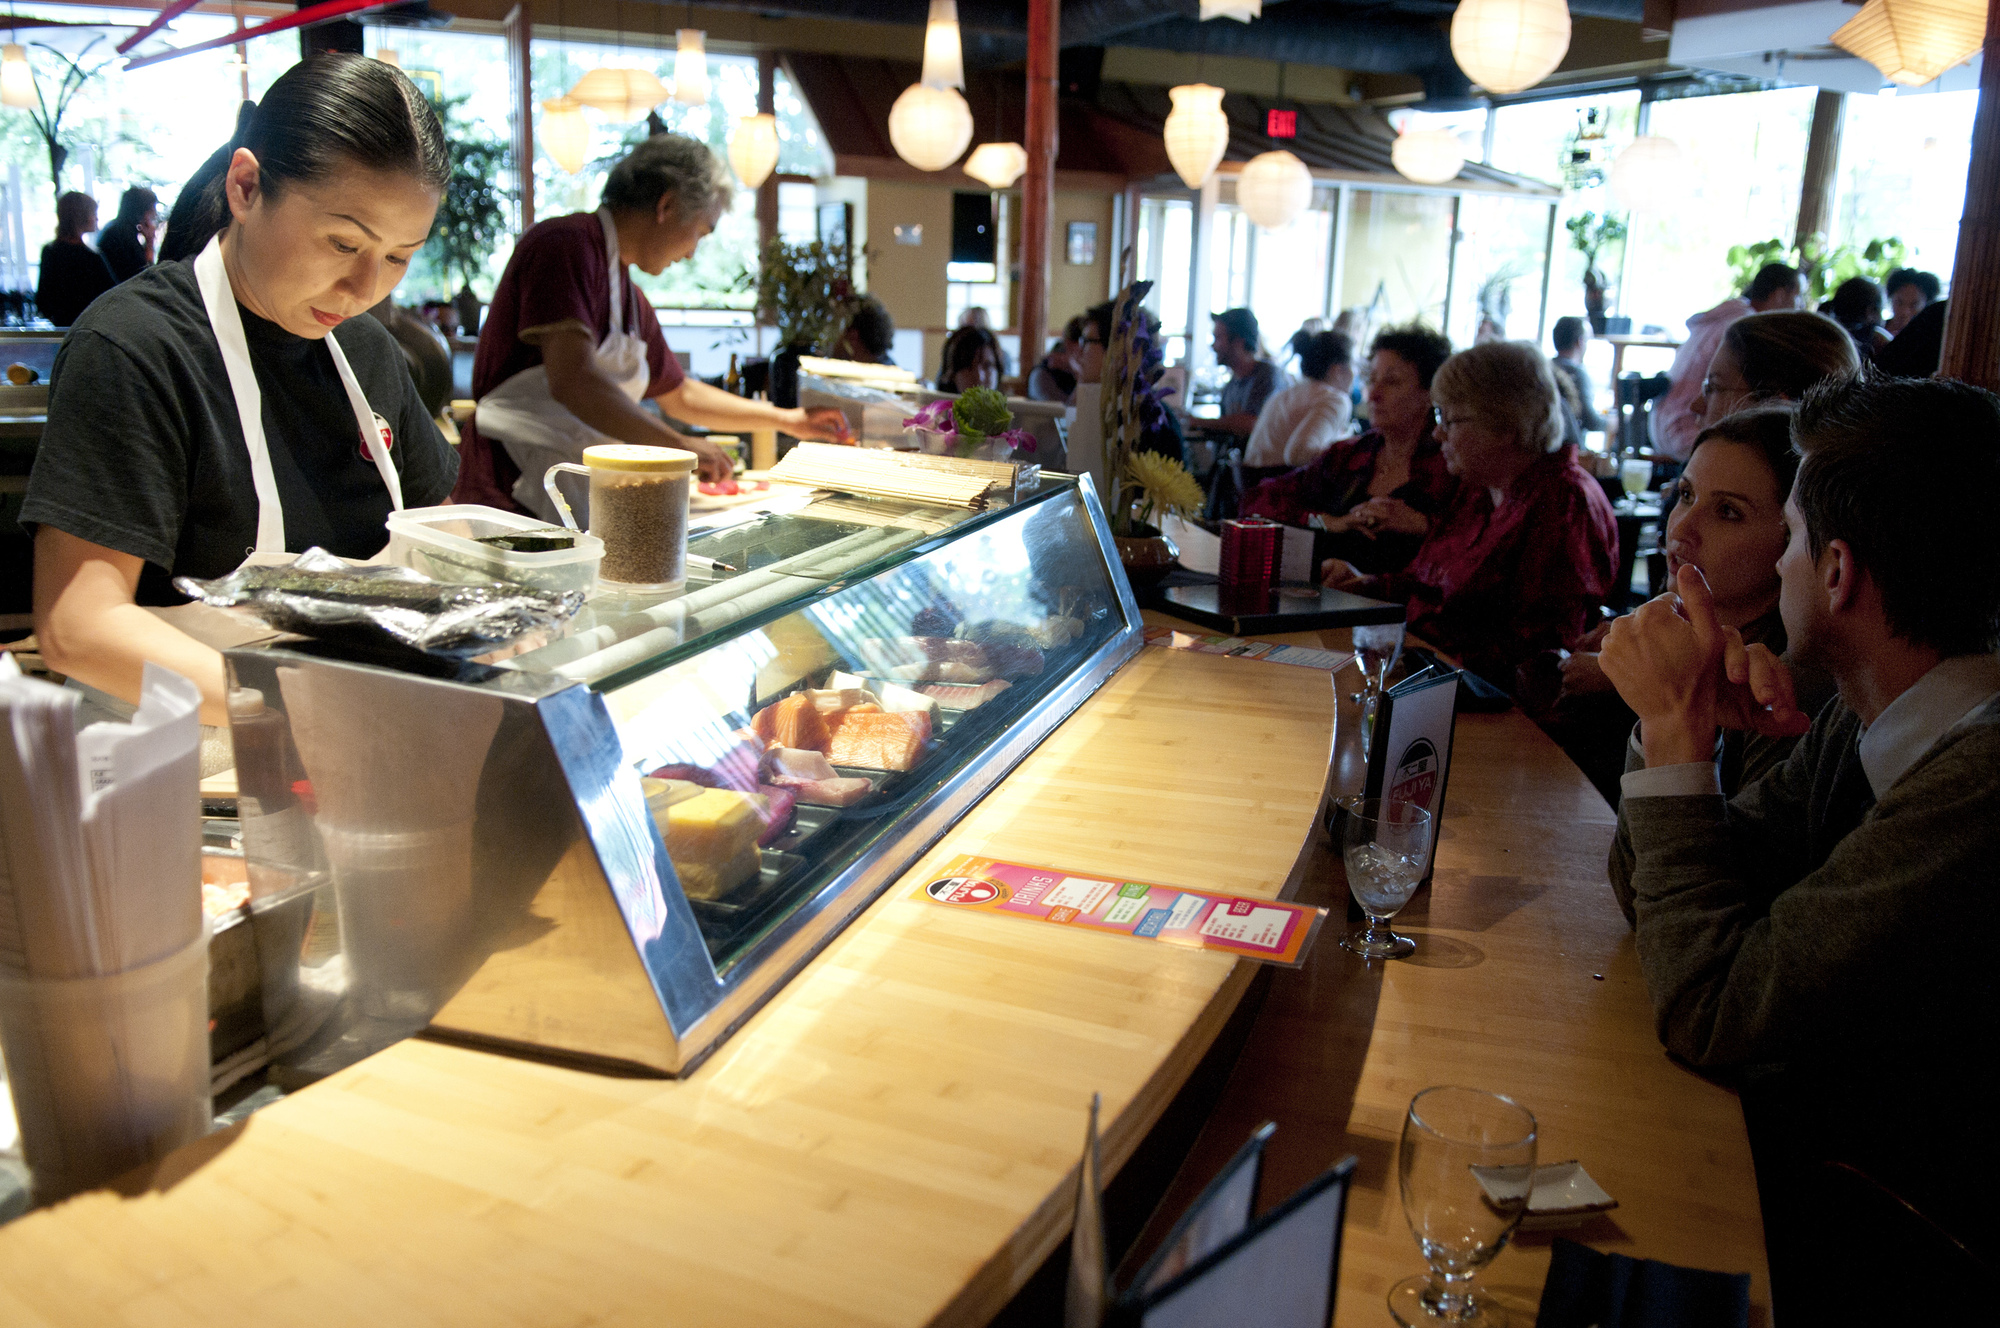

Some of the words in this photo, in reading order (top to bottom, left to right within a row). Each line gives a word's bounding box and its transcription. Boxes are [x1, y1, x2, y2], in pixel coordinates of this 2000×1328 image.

[1008, 875, 1054, 906] DRINKS
[1051, 907, 1073, 922] SAKE
[1232, 901, 1251, 914] BEER
